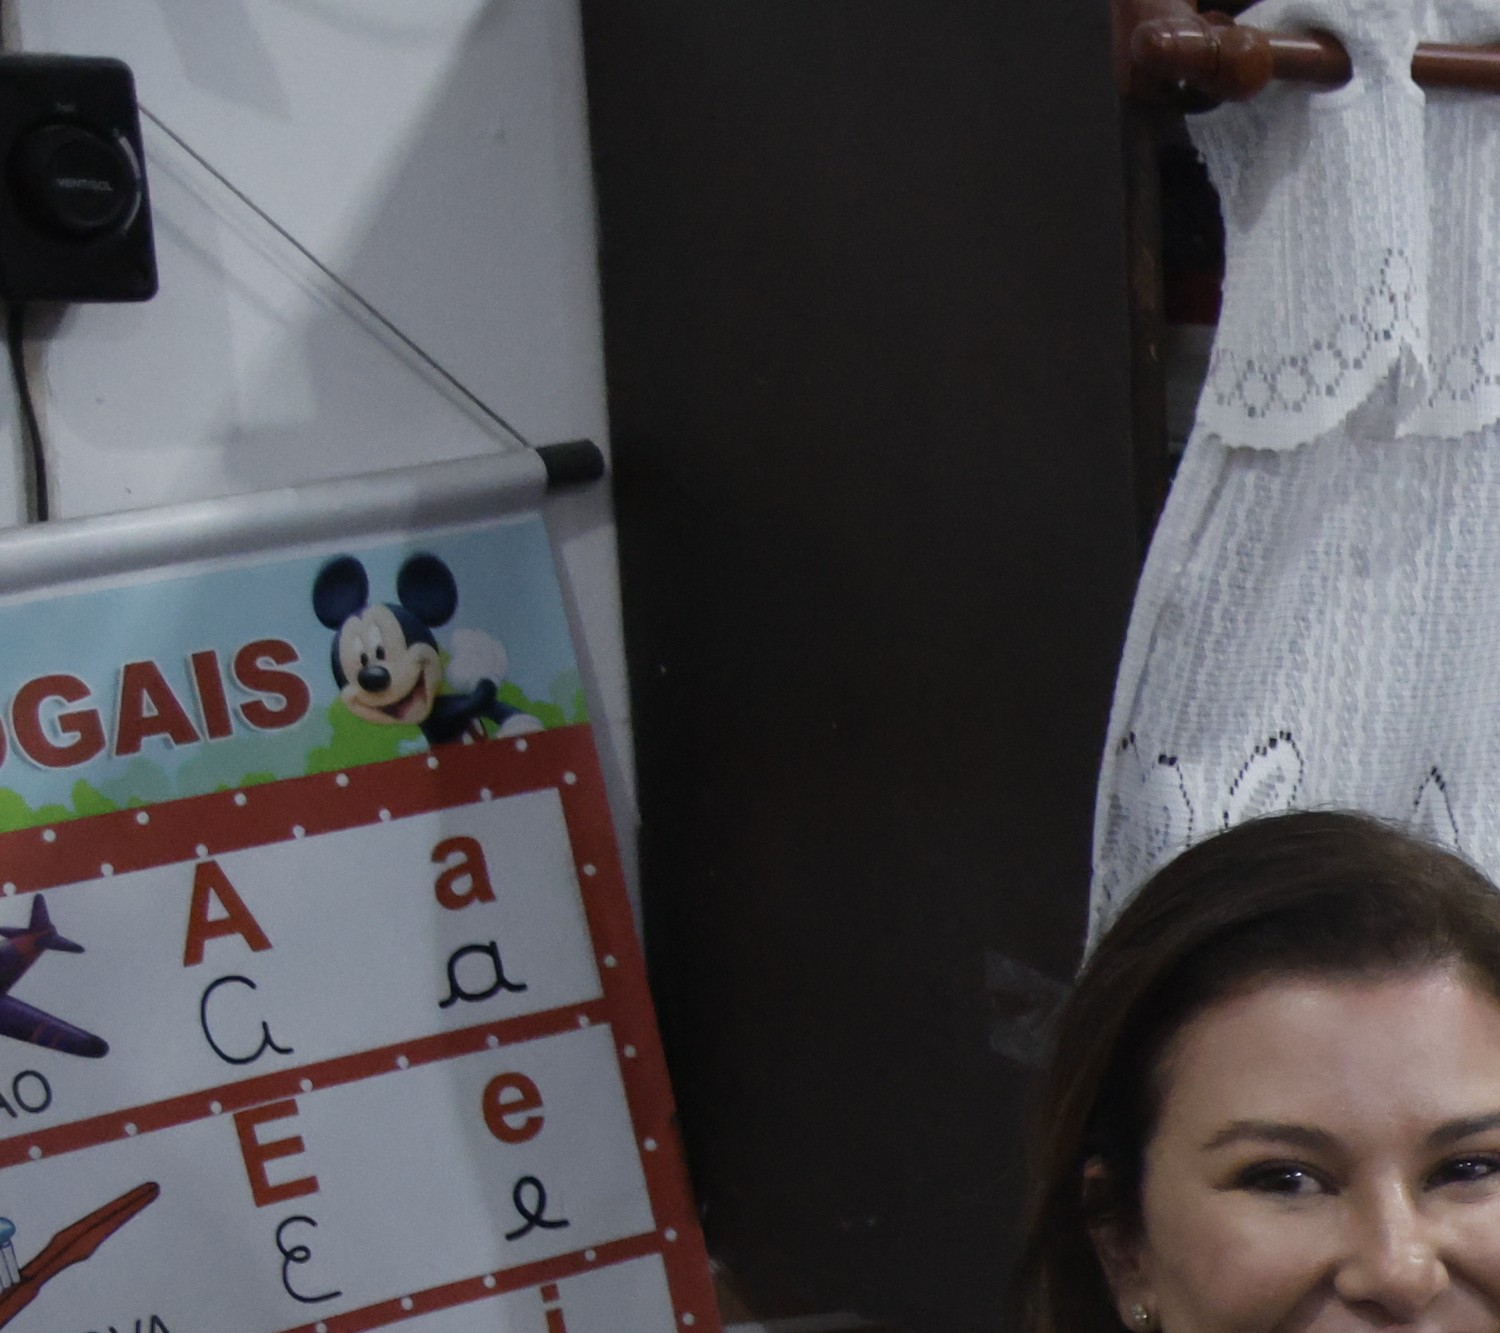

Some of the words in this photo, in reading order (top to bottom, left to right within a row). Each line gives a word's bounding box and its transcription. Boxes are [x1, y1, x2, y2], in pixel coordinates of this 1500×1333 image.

[0, 638, 312, 770] GAIS
[431, 835, 496, 911] a
[183, 860, 272, 967] A
[439, 941, 527, 1008] a
[482, 1071, 545, 1144] e
[233, 1098, 320, 1208] E
[505, 1176, 570, 1240] e
